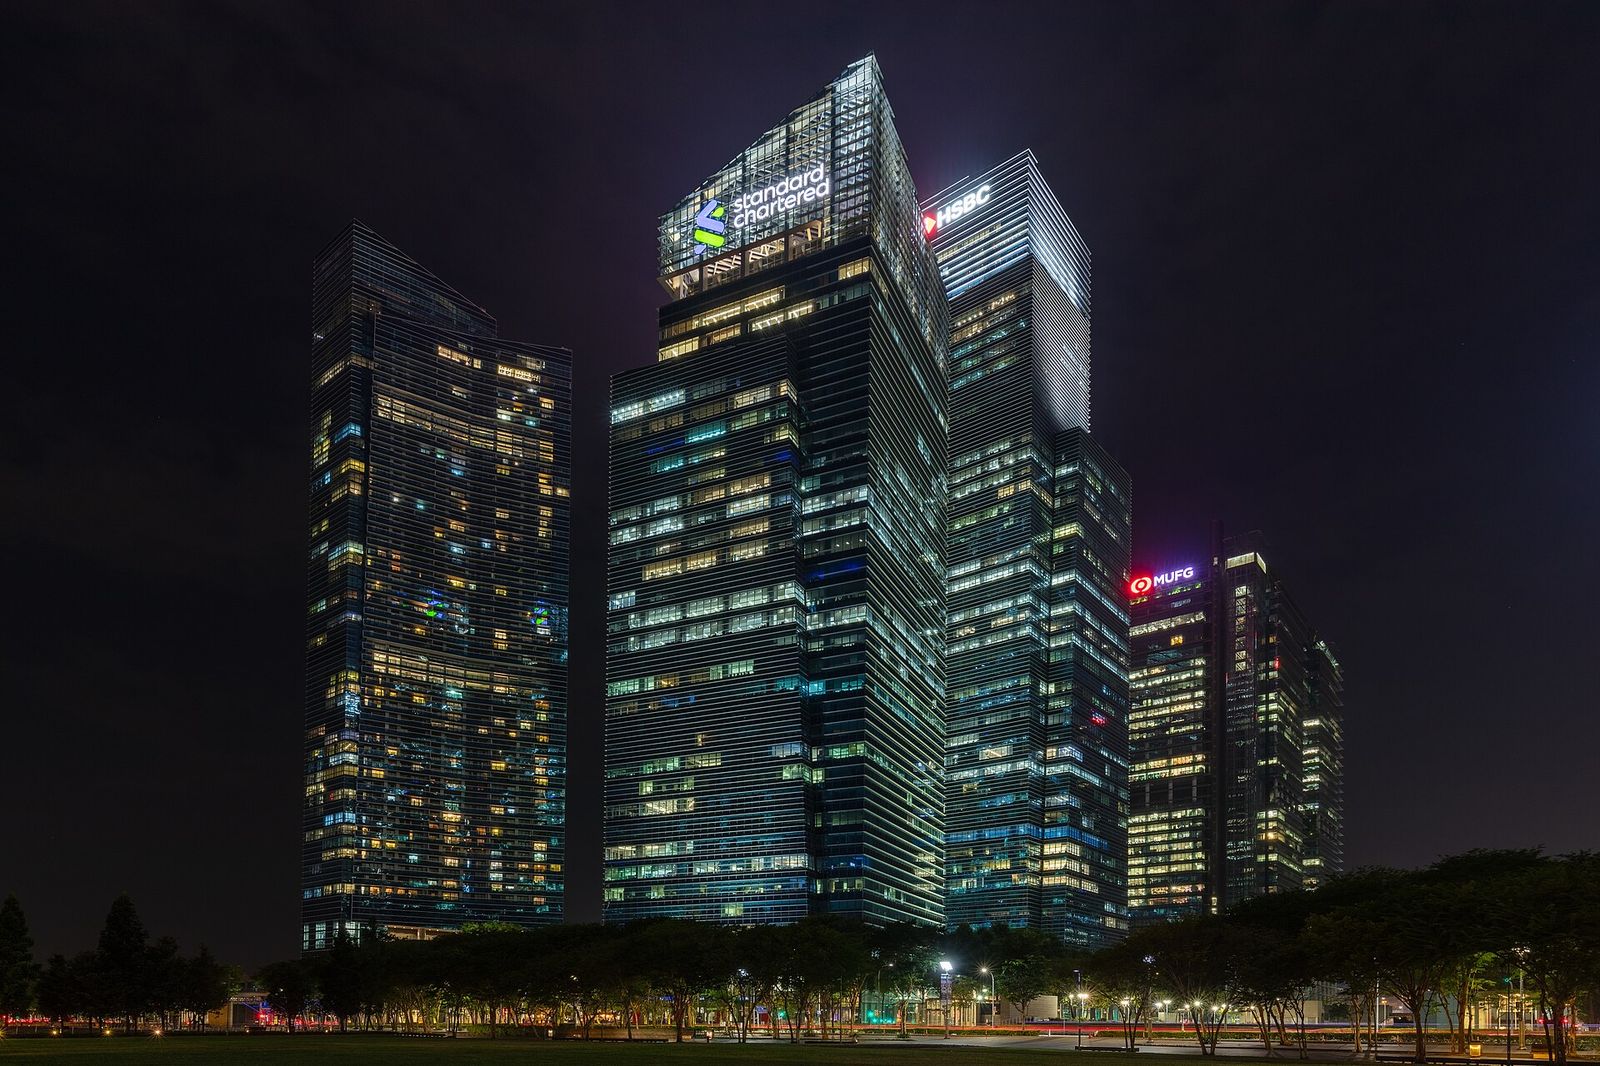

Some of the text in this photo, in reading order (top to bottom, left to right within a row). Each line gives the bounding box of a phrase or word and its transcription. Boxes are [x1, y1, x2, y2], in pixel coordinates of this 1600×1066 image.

[733, 162, 824, 213] standard
[733, 178, 830, 229] chartered
[936, 184, 990, 229] HSBC
[1153, 566, 1194, 587] MUFG
